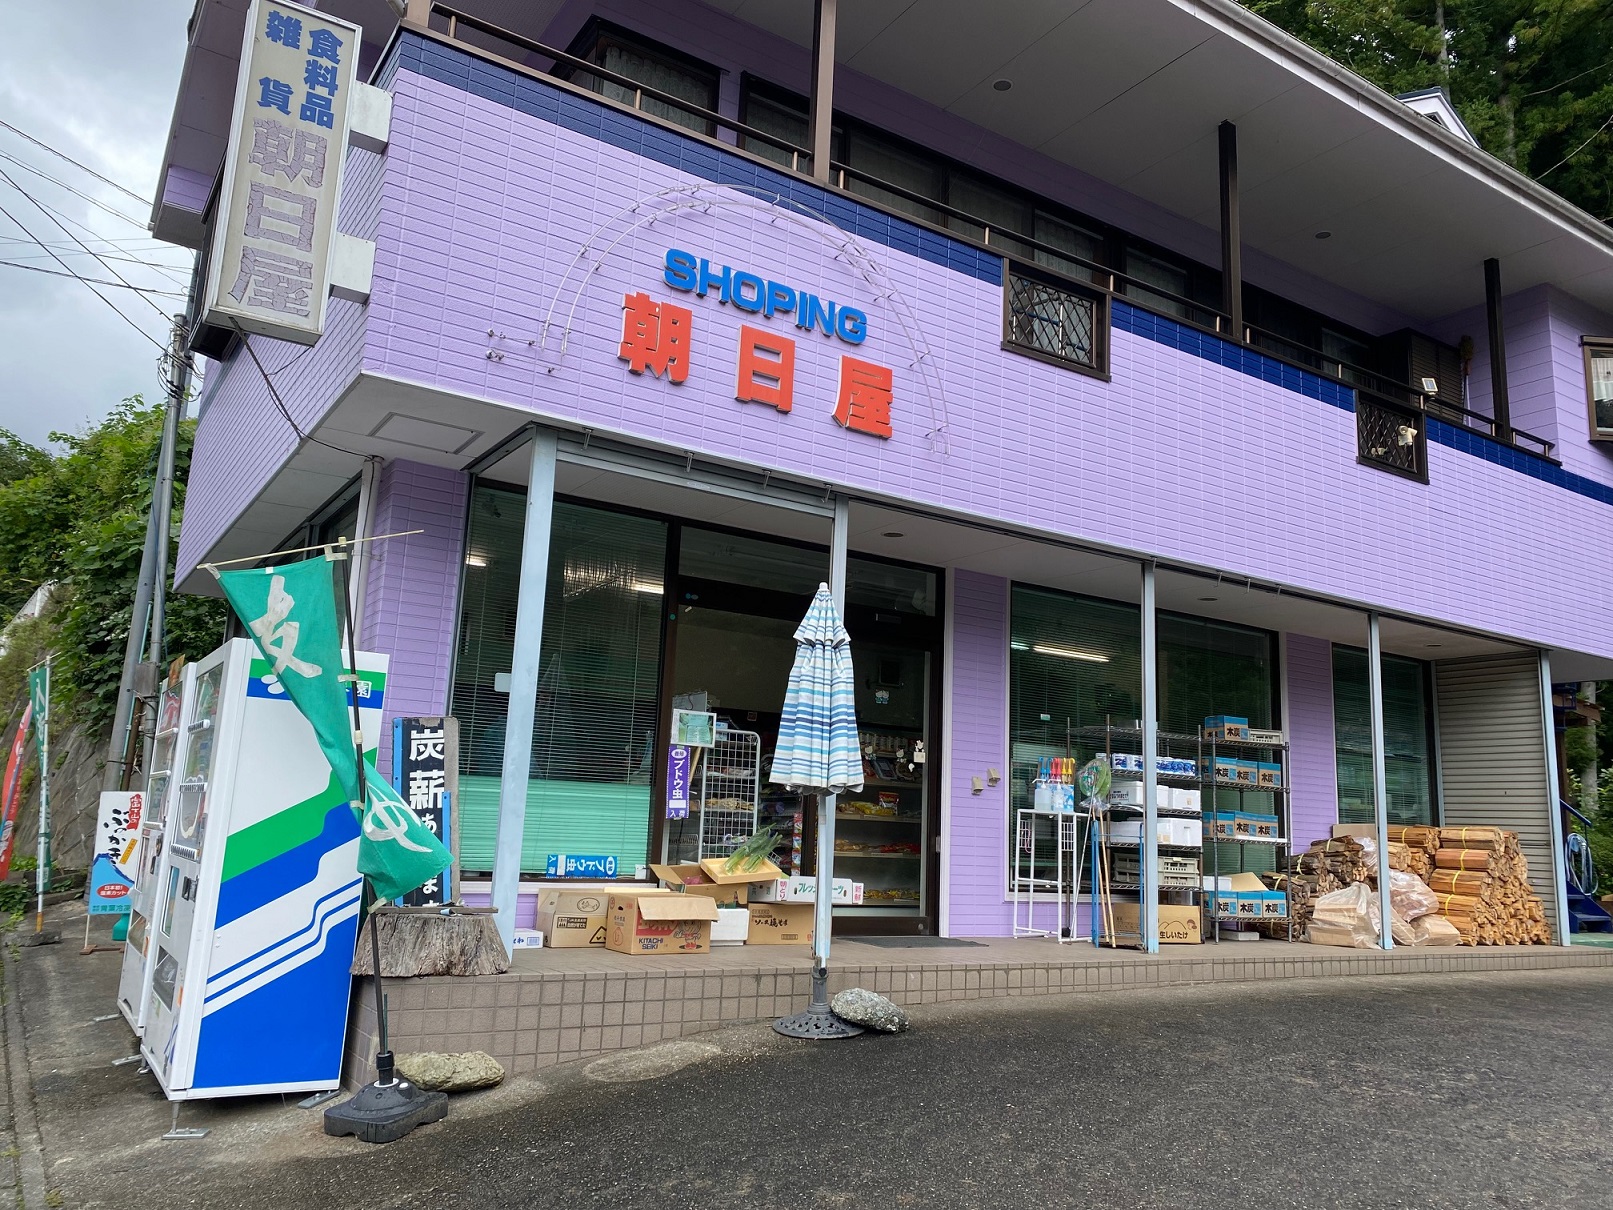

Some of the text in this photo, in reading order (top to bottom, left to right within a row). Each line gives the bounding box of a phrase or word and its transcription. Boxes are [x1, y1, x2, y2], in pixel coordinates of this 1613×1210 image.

[257, 10, 303, 116] 雑貨
[300, 28, 343, 130] 食料品
[227, 117, 327, 318] 朝日屋
[663, 248, 867, 345] SHOPING
[617, 291, 893, 440] 朝日屋
[672, 759, 685, 799] ブドウ虫
[566, 858, 605, 873] ブドウ虫
[1160, 931, 1188, 939] 生しいたけ
[1240, 903, 1254, 913] 木炭
[1265, 903, 1278, 913] 木炭
